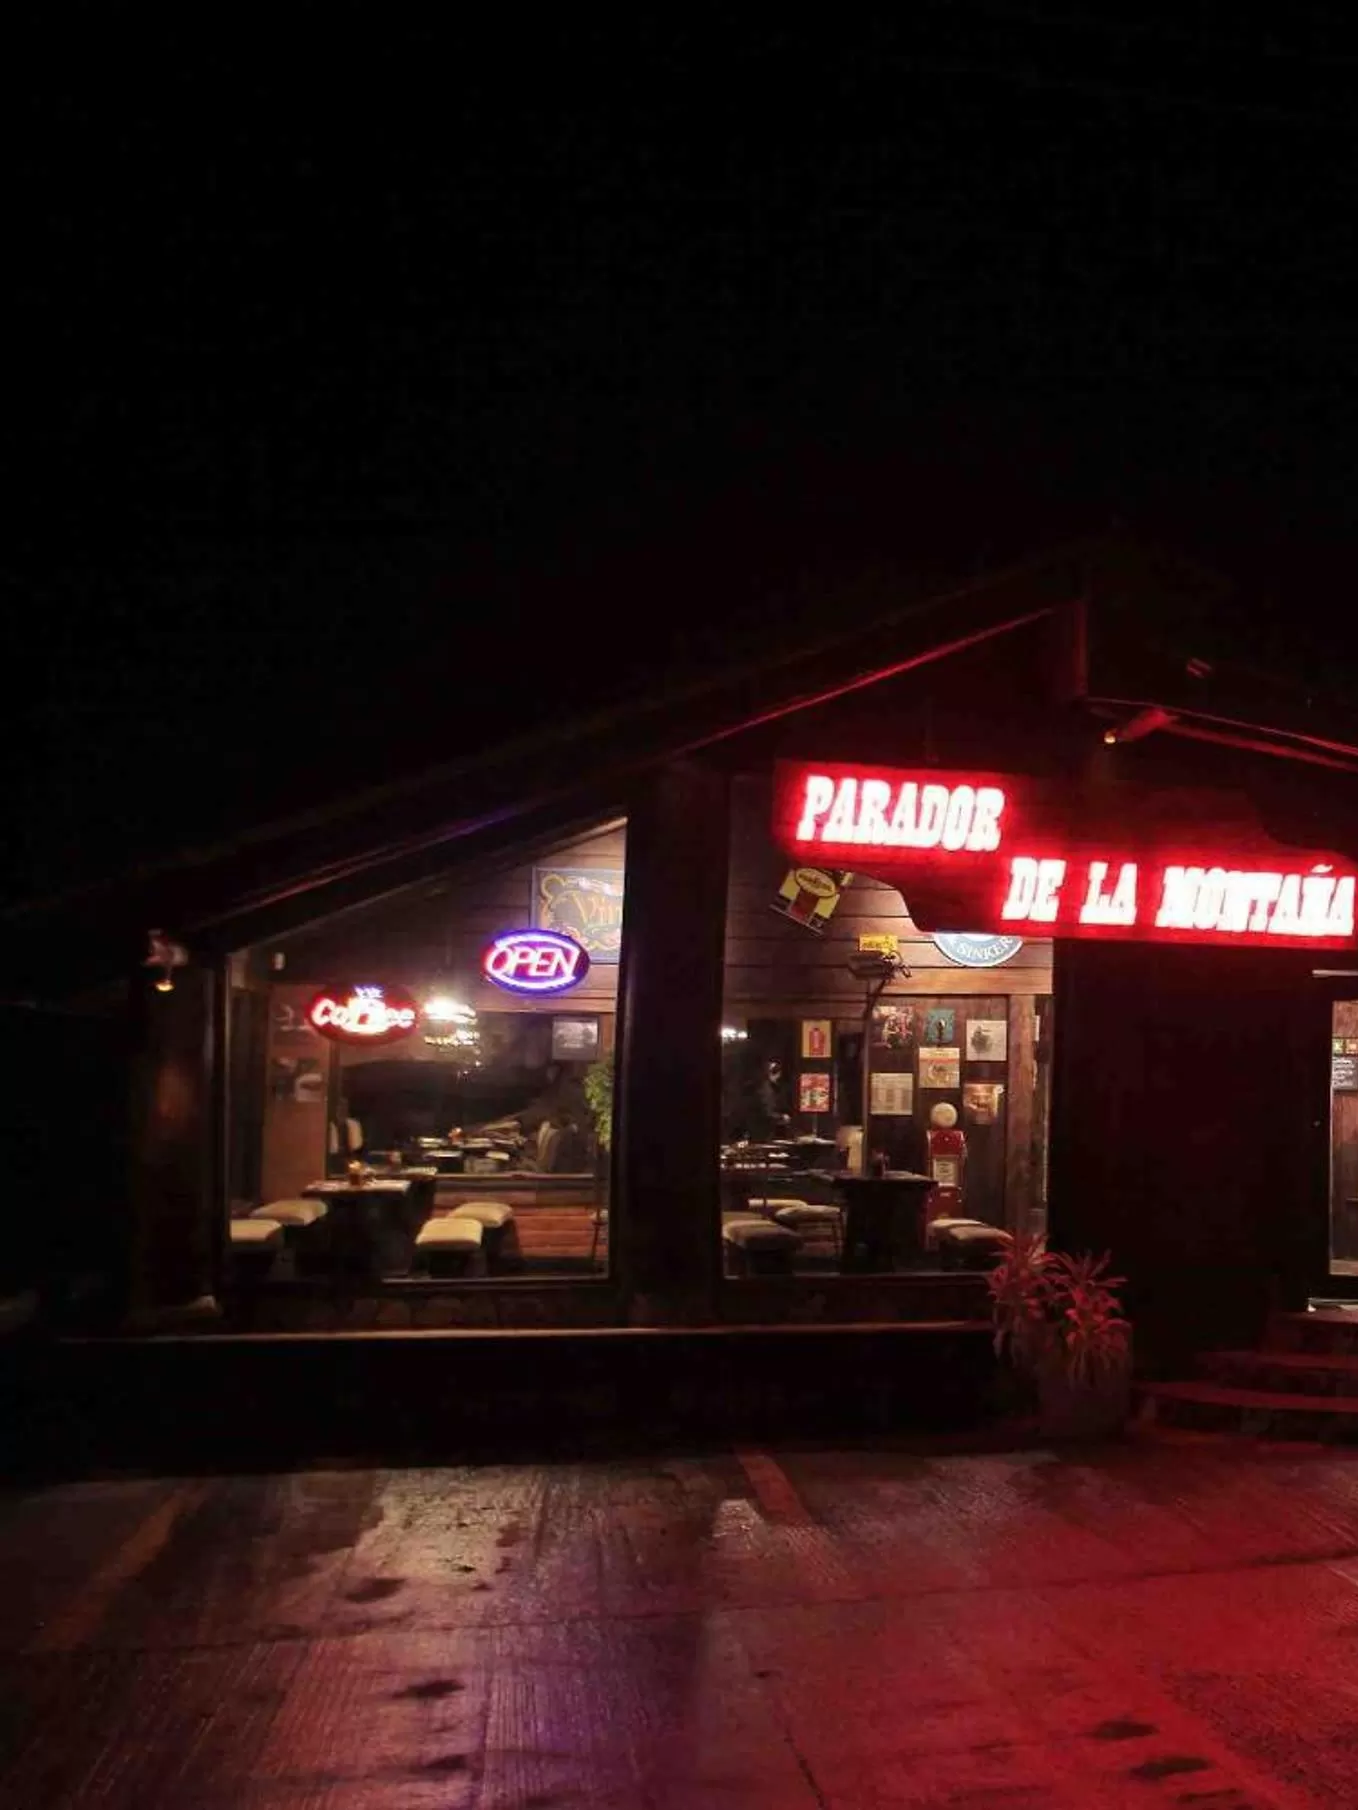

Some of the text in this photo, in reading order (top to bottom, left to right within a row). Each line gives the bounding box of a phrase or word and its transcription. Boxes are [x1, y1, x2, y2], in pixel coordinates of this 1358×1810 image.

[796, 775, 1005, 852] PARADOR
[1002, 857, 1355, 936] DE LA MONTAÑA
[486, 946, 581, 977] OPEN
